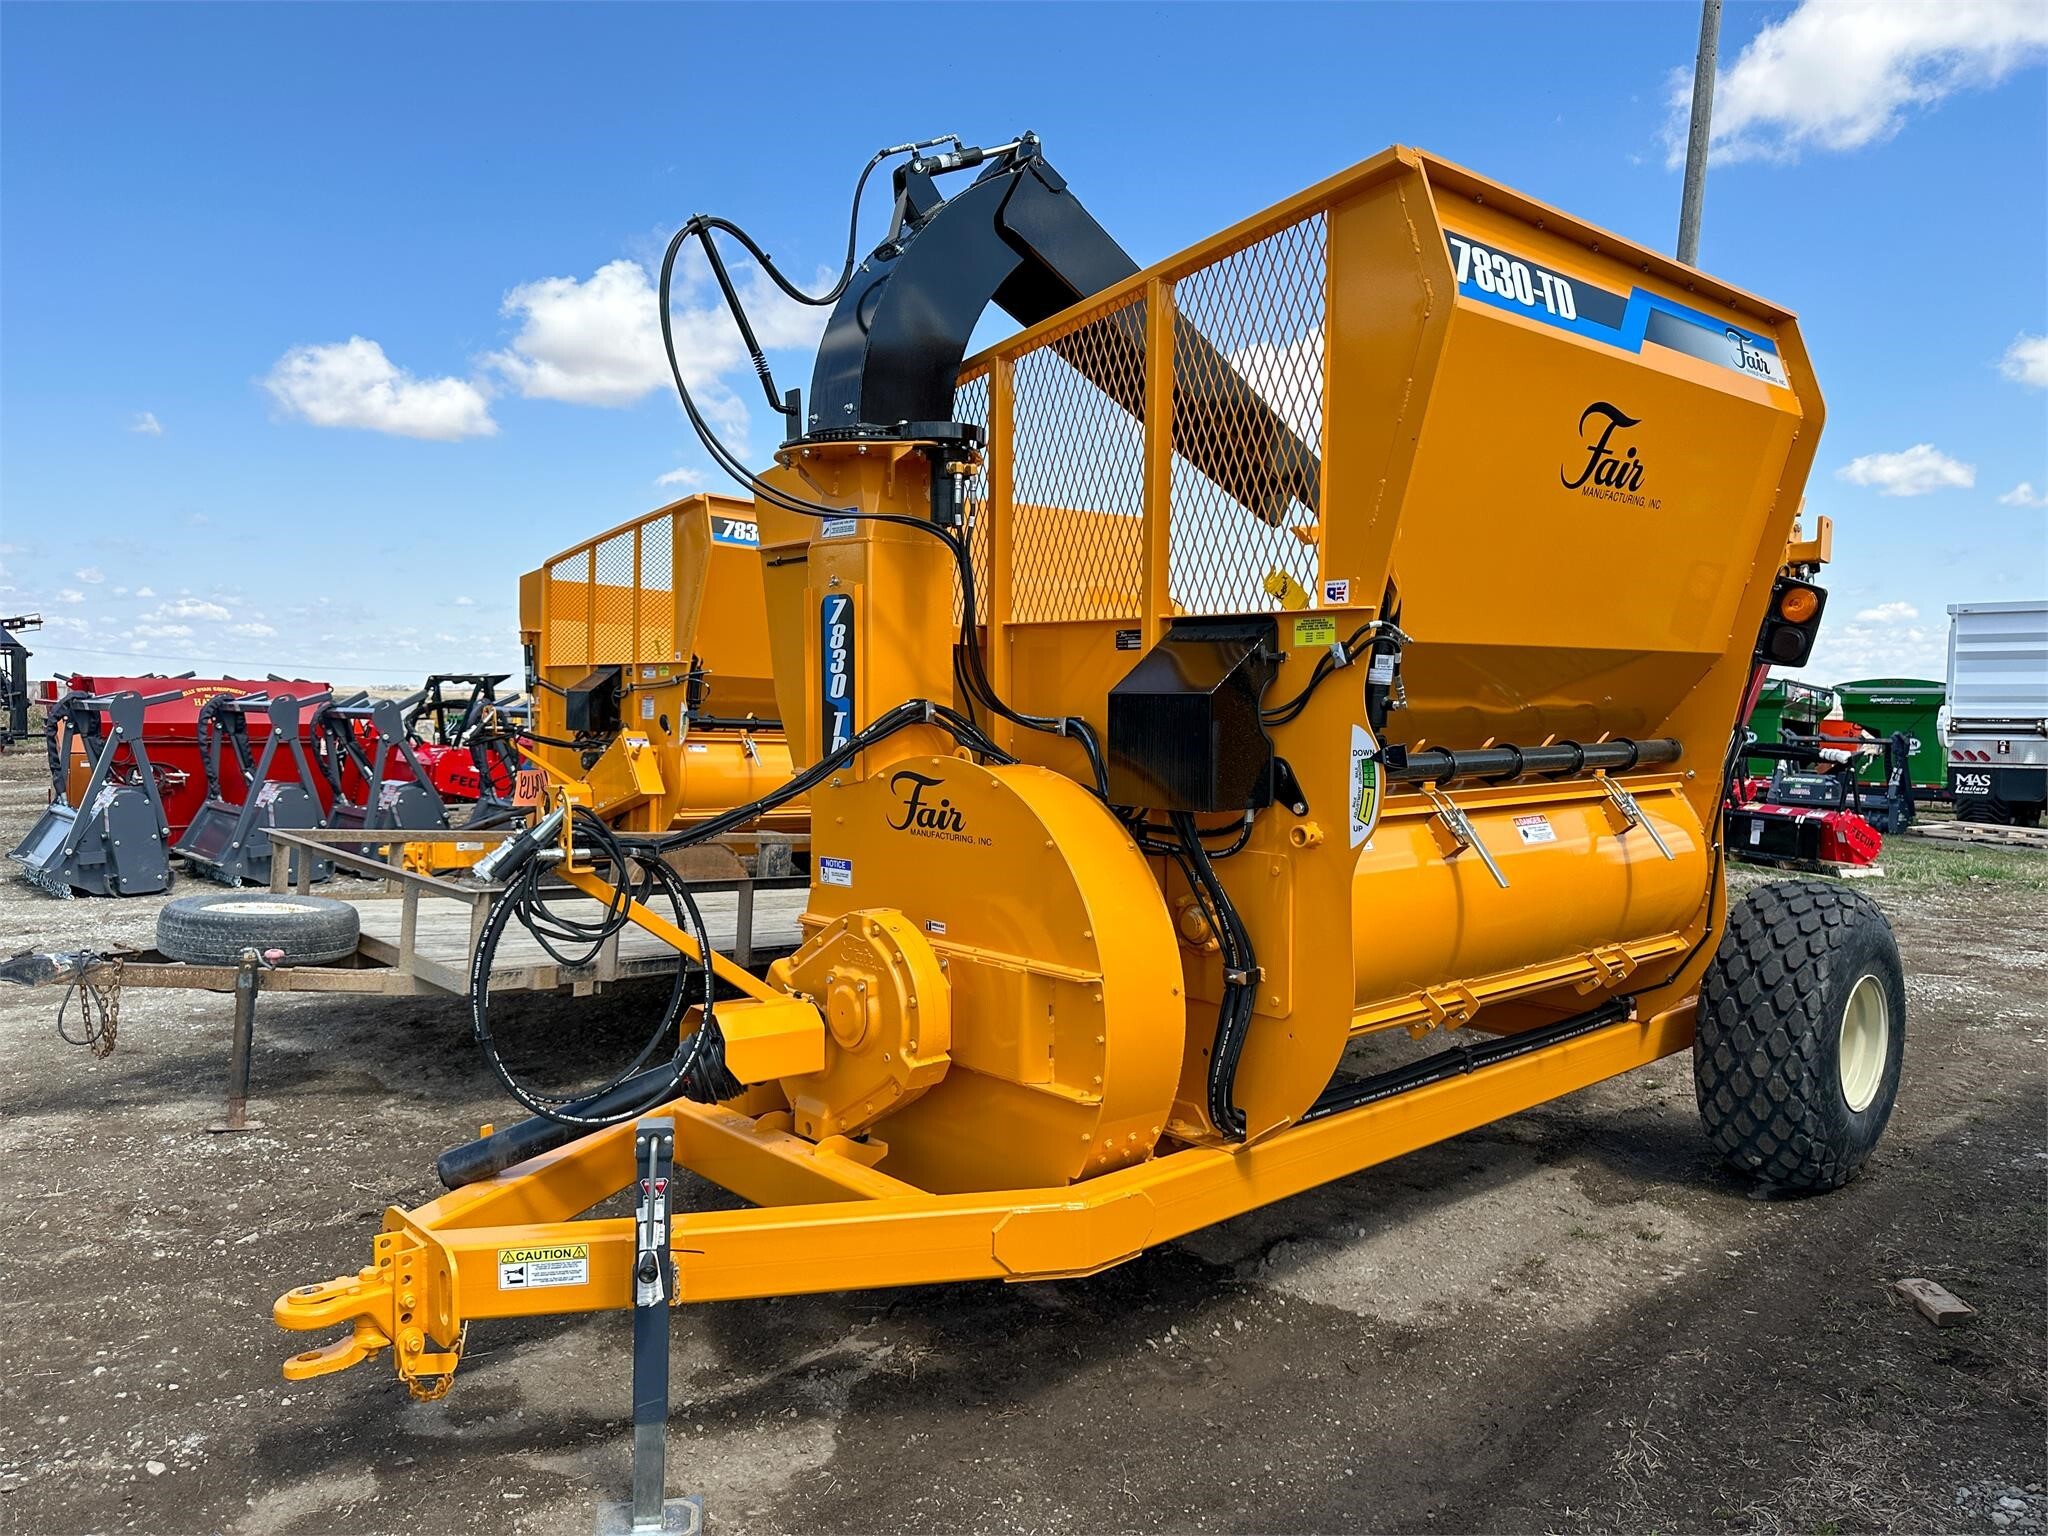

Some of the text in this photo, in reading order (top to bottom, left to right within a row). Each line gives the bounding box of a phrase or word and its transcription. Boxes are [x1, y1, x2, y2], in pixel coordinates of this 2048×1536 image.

[1450, 237, 1577, 321] 7830-TD
[1725, 327, 1771, 375] Fair
[1560, 401, 1646, 492] Fair
[1581, 485, 1662, 510] MANUFACTURING, INC.
[721, 519, 760, 542] 783
[828, 598, 847, 699] 7830
[1352, 749, 1375, 757] DOWN
[449, 773, 480, 790] FEC
[1955, 773, 1991, 787] MAS
[885, 770, 967, 833] Fair
[910, 828, 993, 847] MANUFACTURING, INC
[1353, 825, 1364, 833] UP
[825, 859, 846, 870] NOTICE
[516, 1249, 572, 1262] CAUTION
